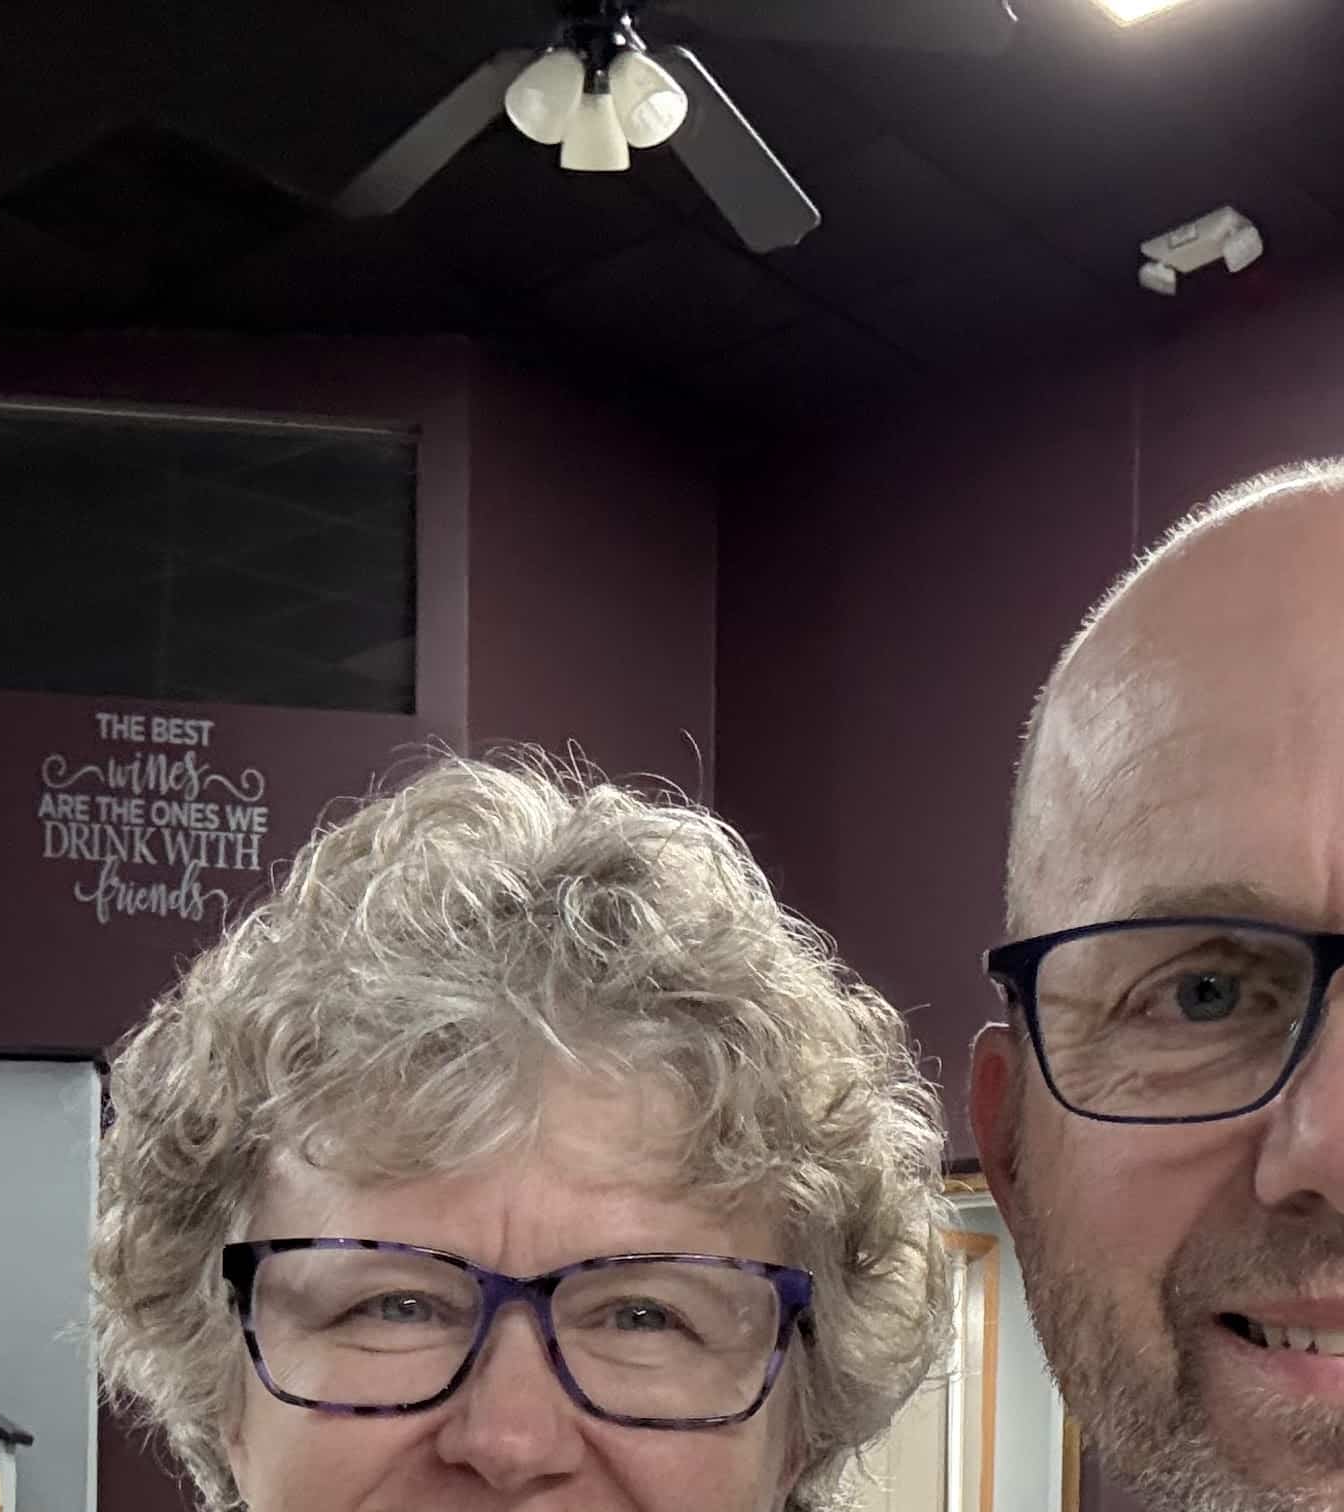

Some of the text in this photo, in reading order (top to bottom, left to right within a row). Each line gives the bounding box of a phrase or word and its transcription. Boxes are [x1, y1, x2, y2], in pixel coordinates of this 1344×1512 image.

[96, 712, 215, 746] THE BEST
[107, 750, 208, 800] wines
[38, 794, 269, 833] ARE THE ONES WE
[42, 823, 261, 870] DRINK WITH
[74, 859, 227, 924] friends
